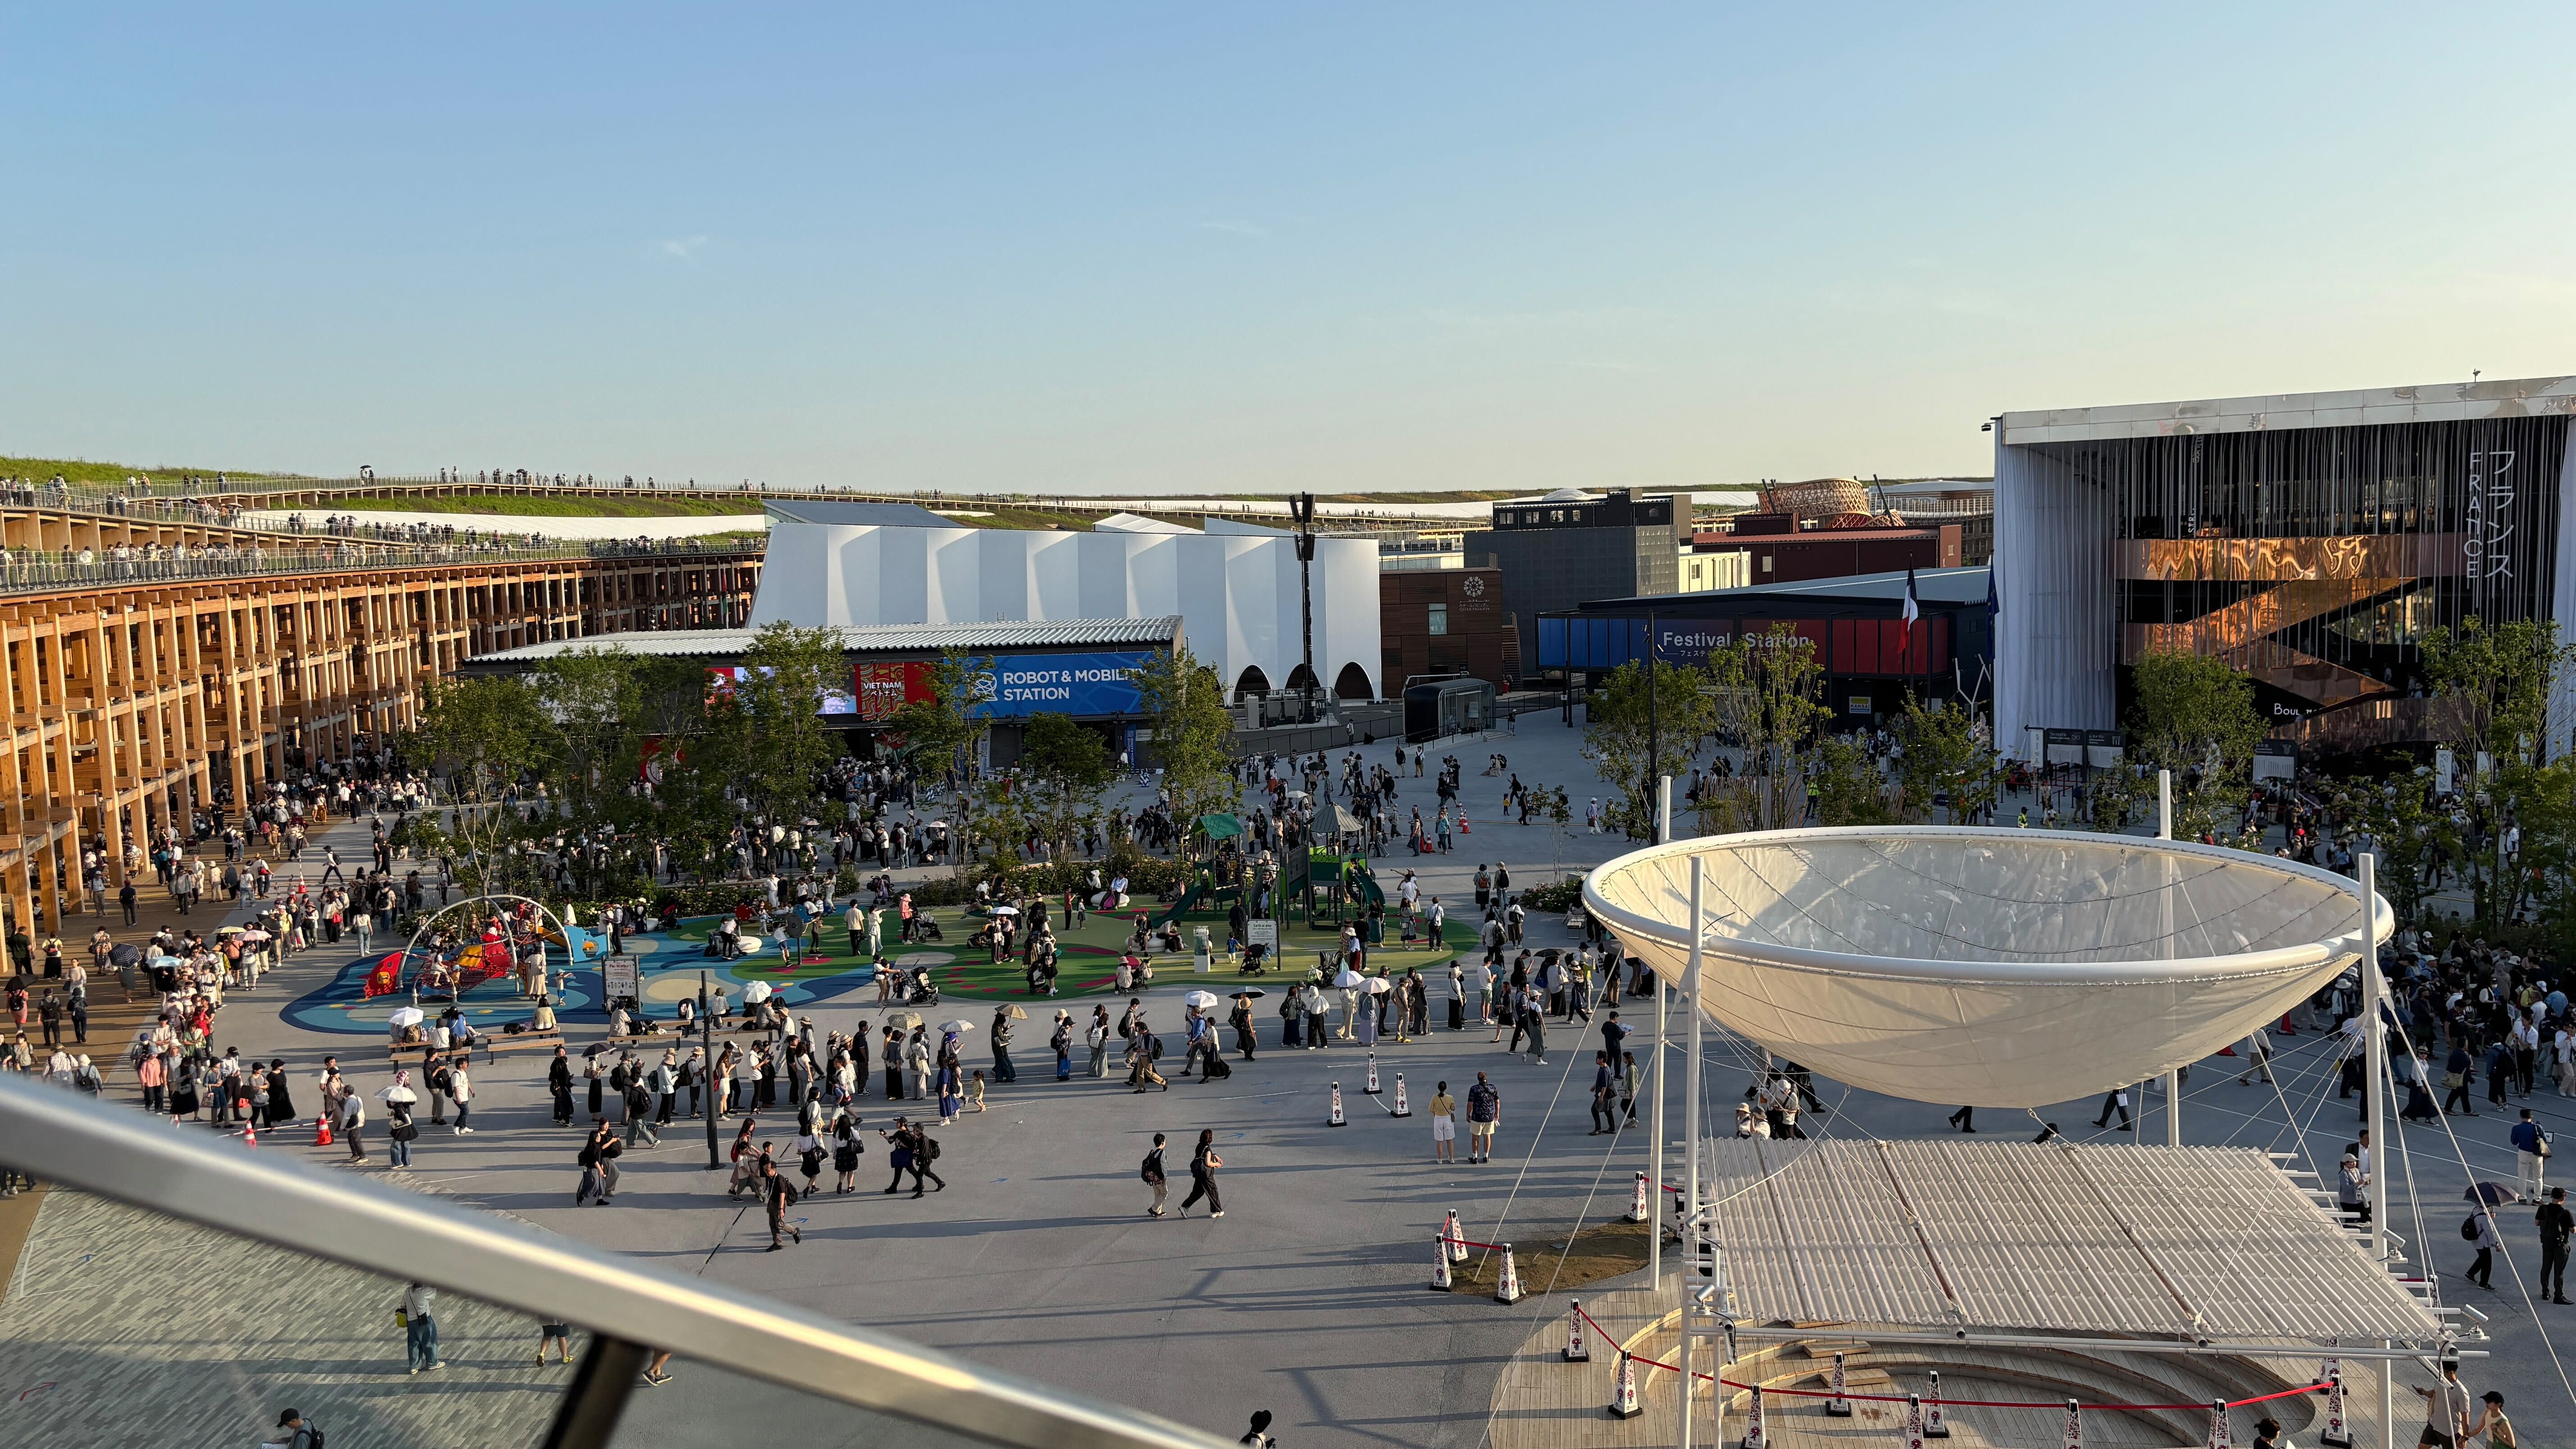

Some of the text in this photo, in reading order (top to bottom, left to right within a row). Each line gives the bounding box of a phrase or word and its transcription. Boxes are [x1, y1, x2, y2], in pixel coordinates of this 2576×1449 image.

[2464, 452, 2482, 578] FRANCE
[2485, 451, 2515, 578] フランス
[1663, 632, 1730, 647] Festival
[1003, 671, 1059, 685] ROBOT
[1061, 670, 1072, 682] &
[1004, 687, 1069, 701] STATION
